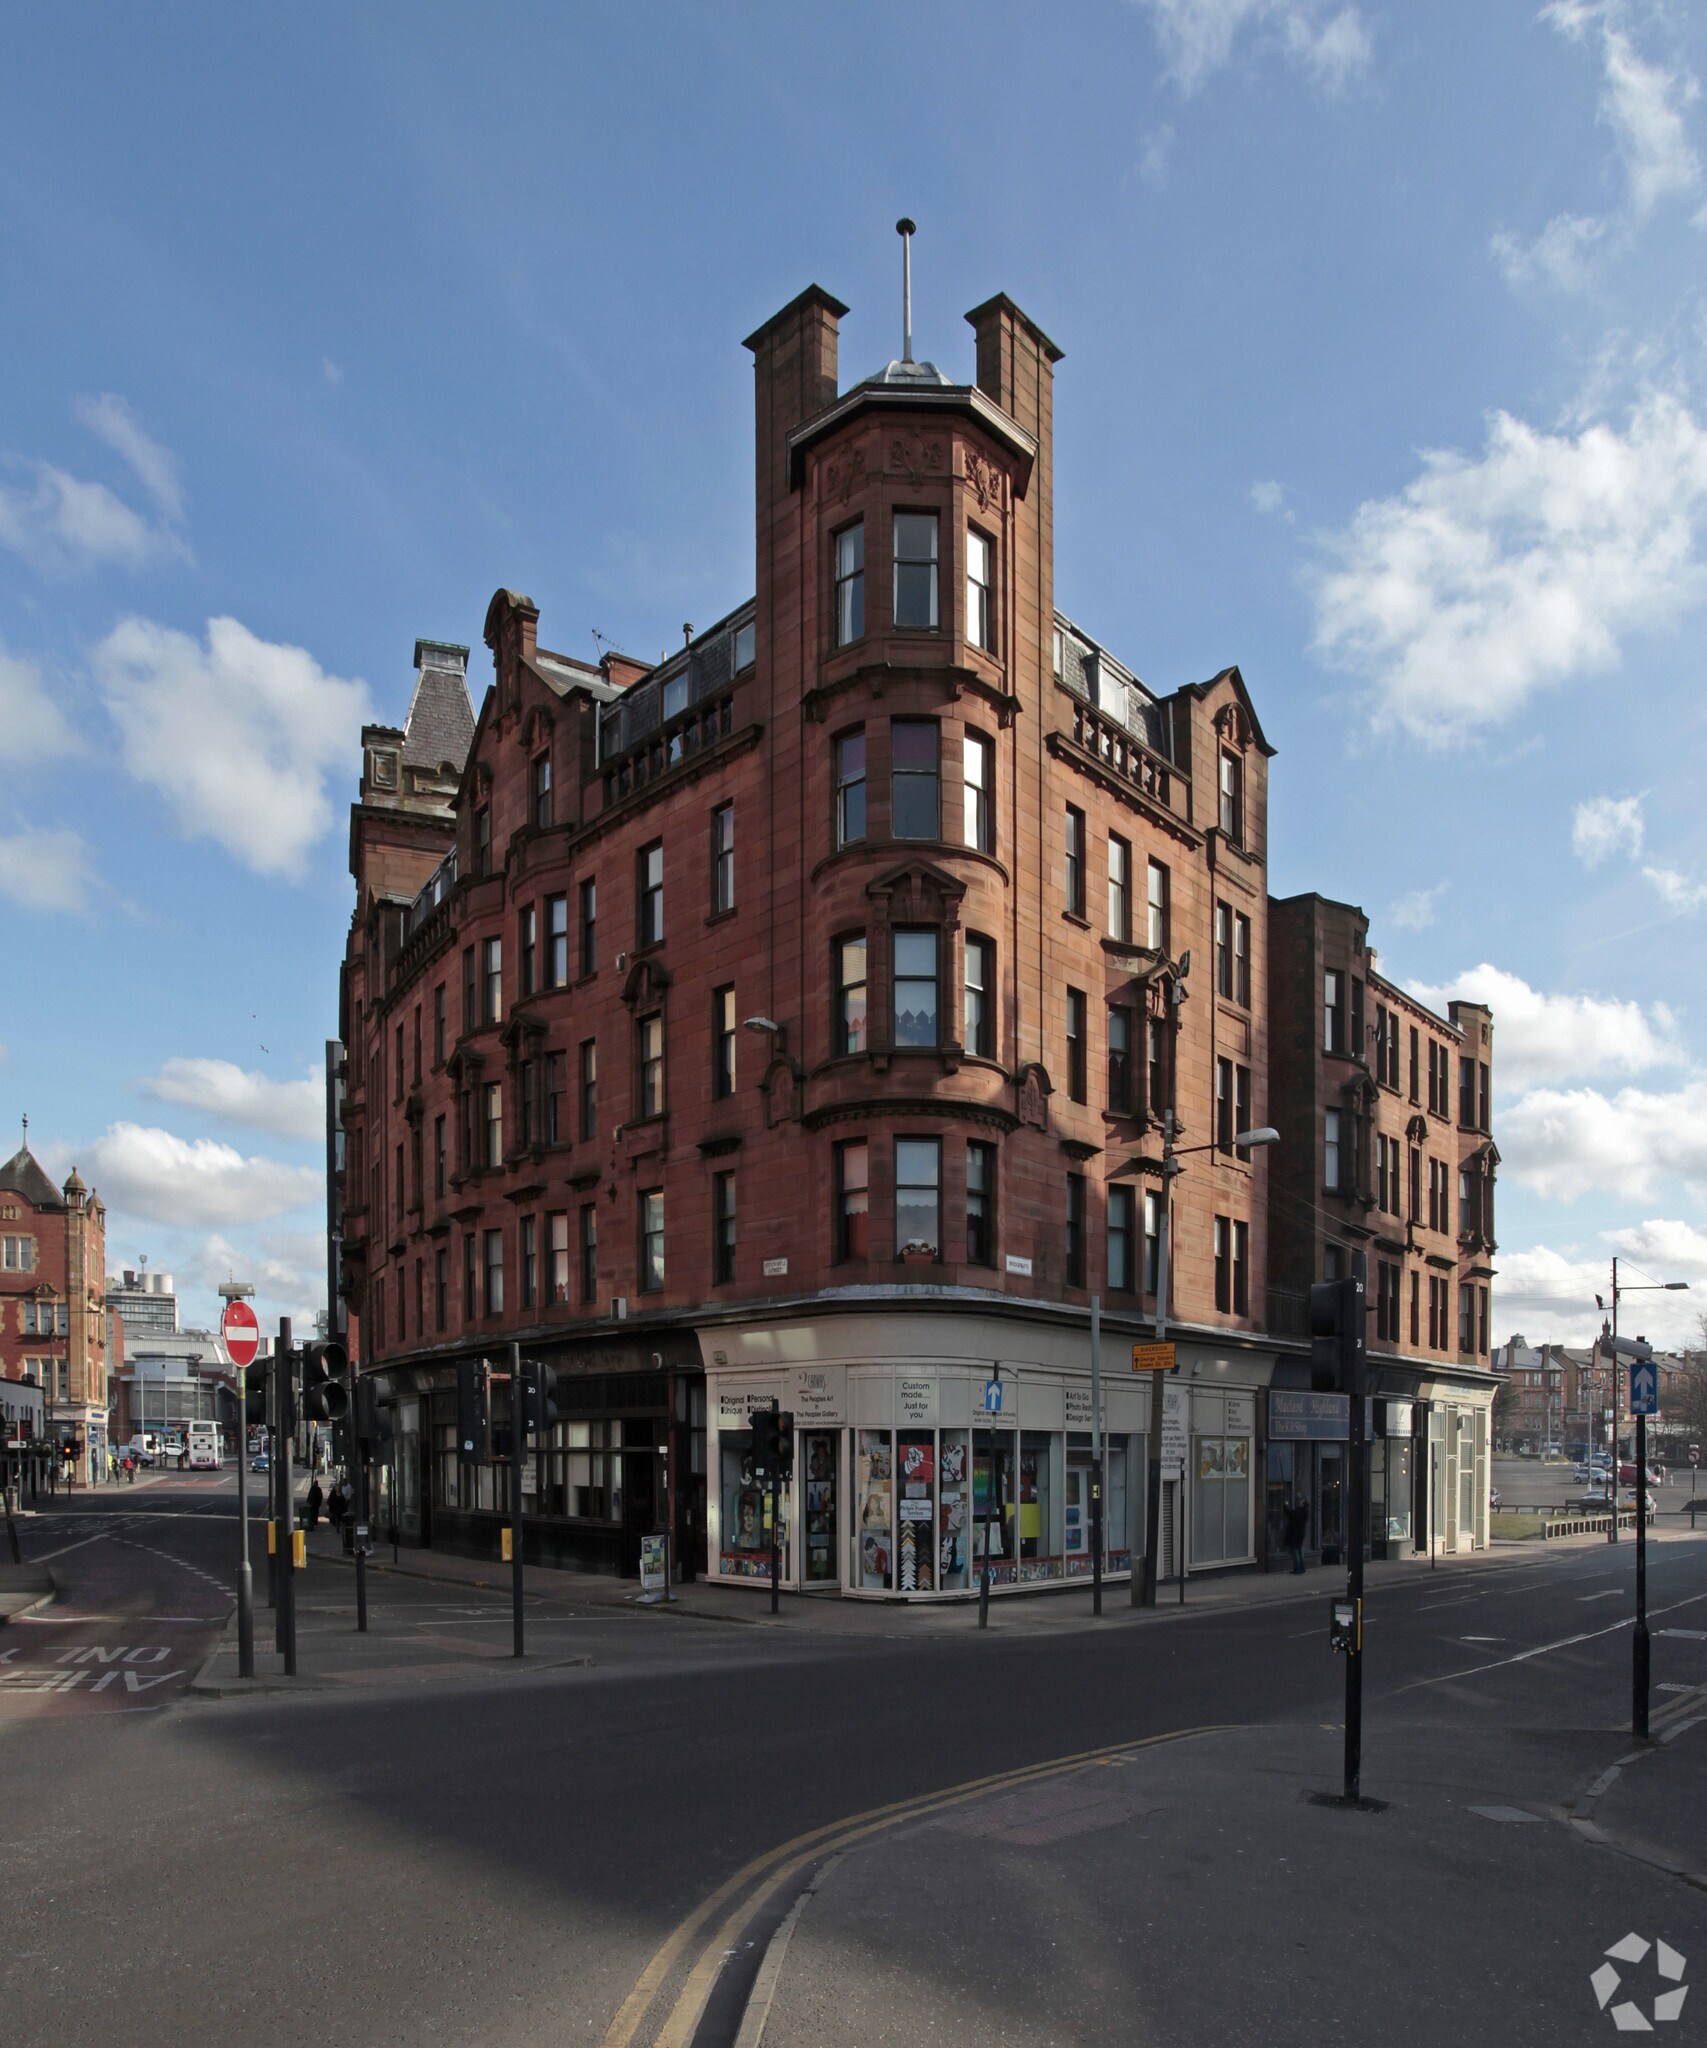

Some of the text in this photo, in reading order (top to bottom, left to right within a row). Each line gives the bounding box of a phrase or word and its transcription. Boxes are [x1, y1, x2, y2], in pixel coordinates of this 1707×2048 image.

[1356, 1282, 1364, 1293] 20
[1356, 1338, 1362, 1348] 21
[527, 1386, 536, 1394] 20
[902, 1382, 930, 1390] Custom
[724, 1394, 774, 1406] Original Personal
[903, 1402, 928, 1410] Just for
[724, 1406, 743, 1415] Unique
[822, 1410, 839, 1418] Gallery
[909, 1411, 923, 1419] you
